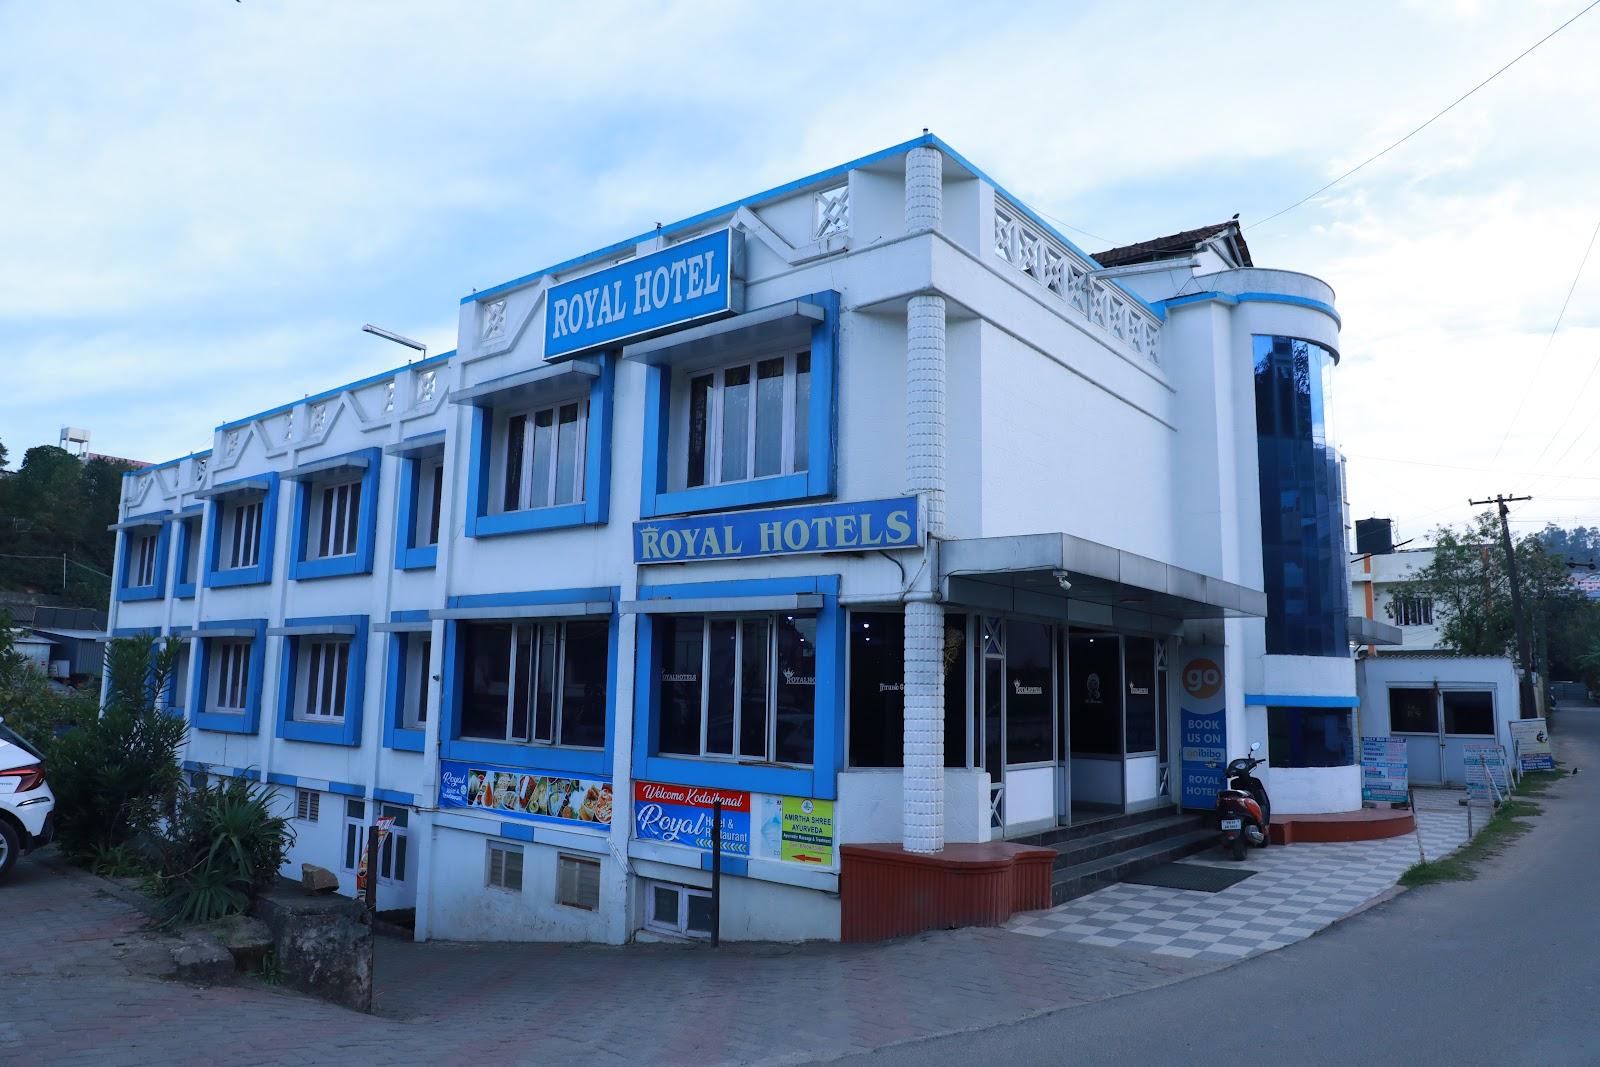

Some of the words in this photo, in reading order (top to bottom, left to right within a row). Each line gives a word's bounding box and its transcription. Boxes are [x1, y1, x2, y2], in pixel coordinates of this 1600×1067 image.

[552, 280, 627, 340] ROYAL
[633, 250, 721, 316] HOTEL
[641, 525, 743, 559] ROYAL
[759, 510, 912, 552] HOTELS
[1186, 668, 1219, 692] go
[1188, 719, 1220, 730] BOOK
[1187, 733, 1201, 743] US
[1203, 733, 1221, 744] ON
[442, 771, 466, 787] Royal
[1188, 775, 1220, 785] ROYAL
[642, 784, 684, 801] Welcome
[637, 803, 705, 841] Royal
[705, 816, 724, 829] Hel
[727, 818, 734, 829] &
[784, 813, 810, 823] AMIRTHA
[811, 816, 832, 826] SHREE
[705, 828, 747, 843] Rtaurant
[791, 824, 823, 834] AYURVEDA
